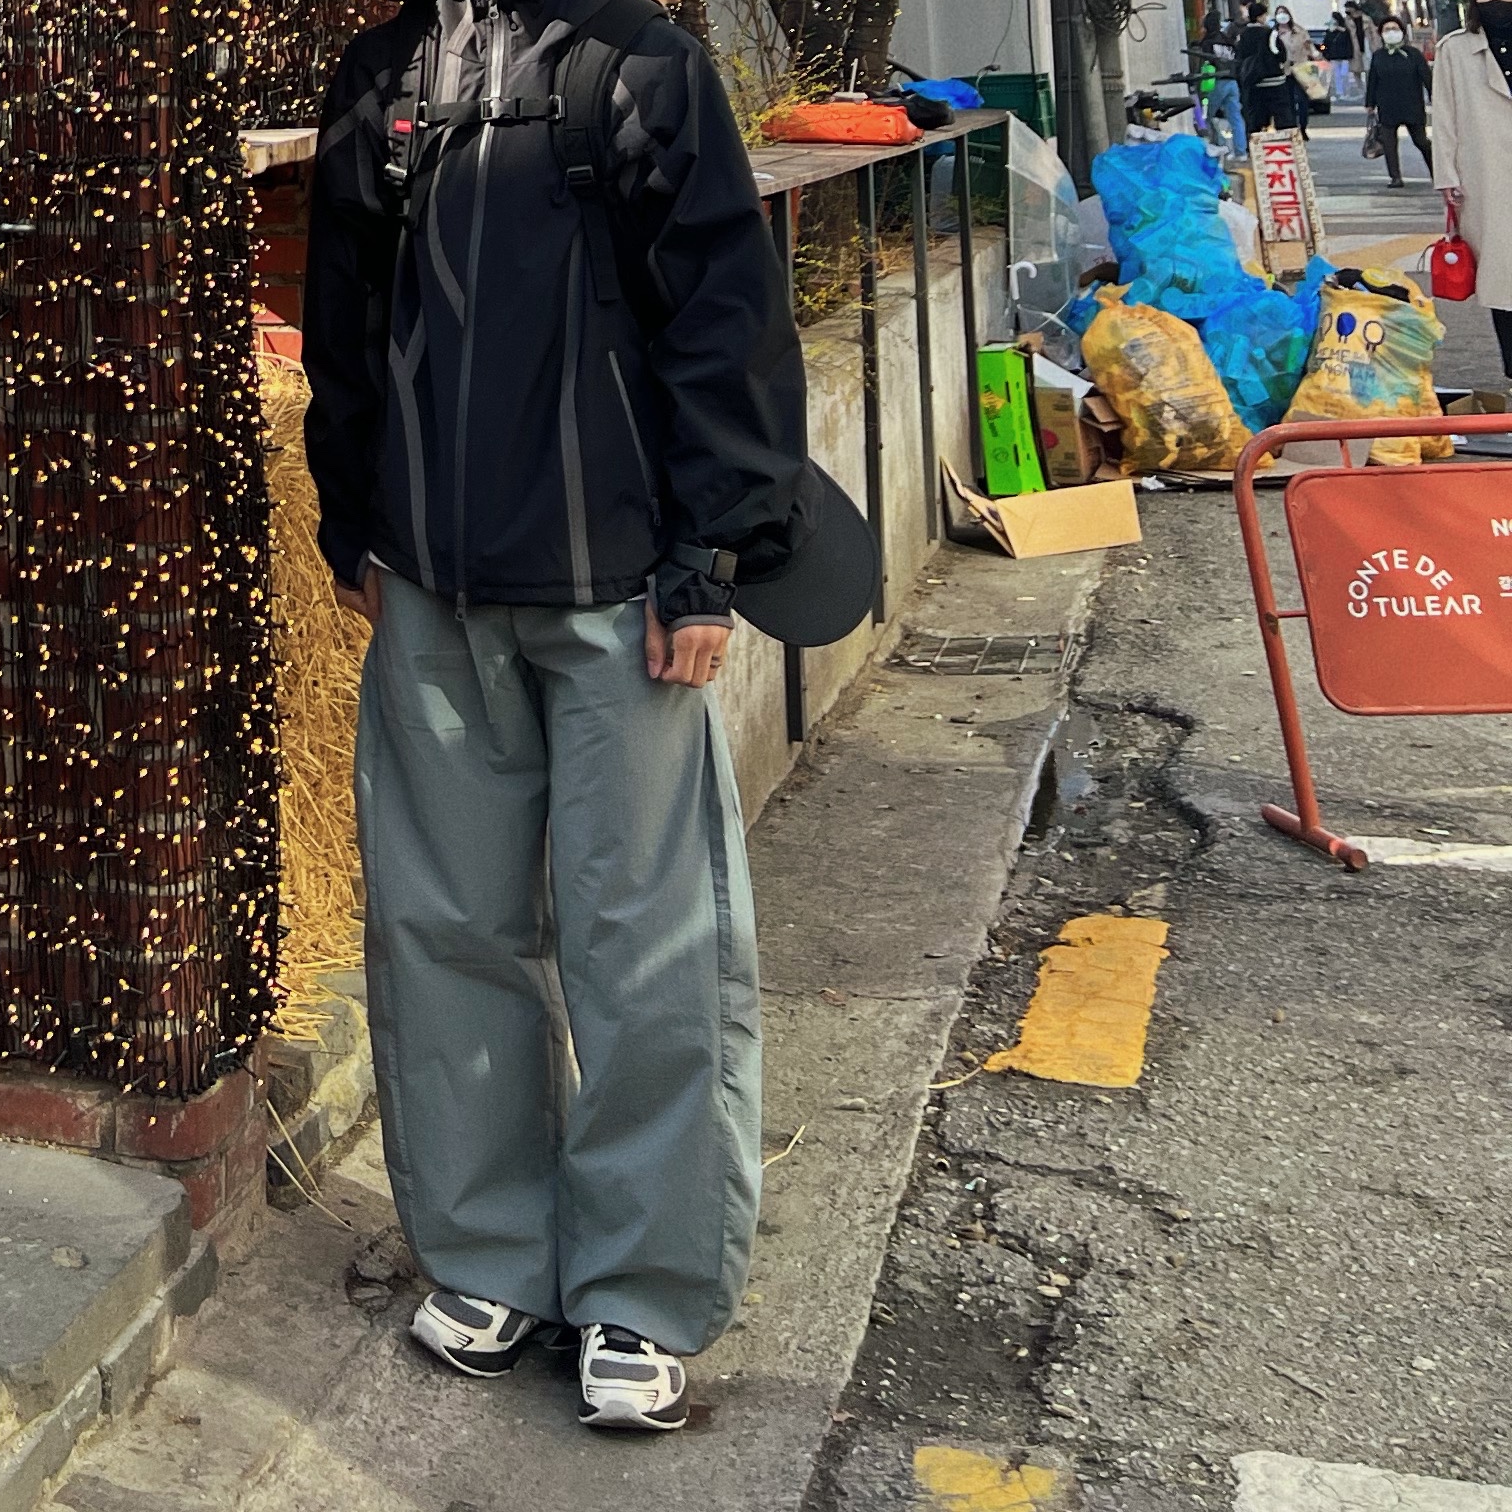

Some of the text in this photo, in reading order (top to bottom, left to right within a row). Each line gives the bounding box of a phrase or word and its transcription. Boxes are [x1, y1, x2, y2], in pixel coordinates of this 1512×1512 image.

[1263, 144, 1306, 239] 주차금지
[1348, 549, 1454, 618] CONTE DE
[1372, 594, 1483, 618] TULEAR
